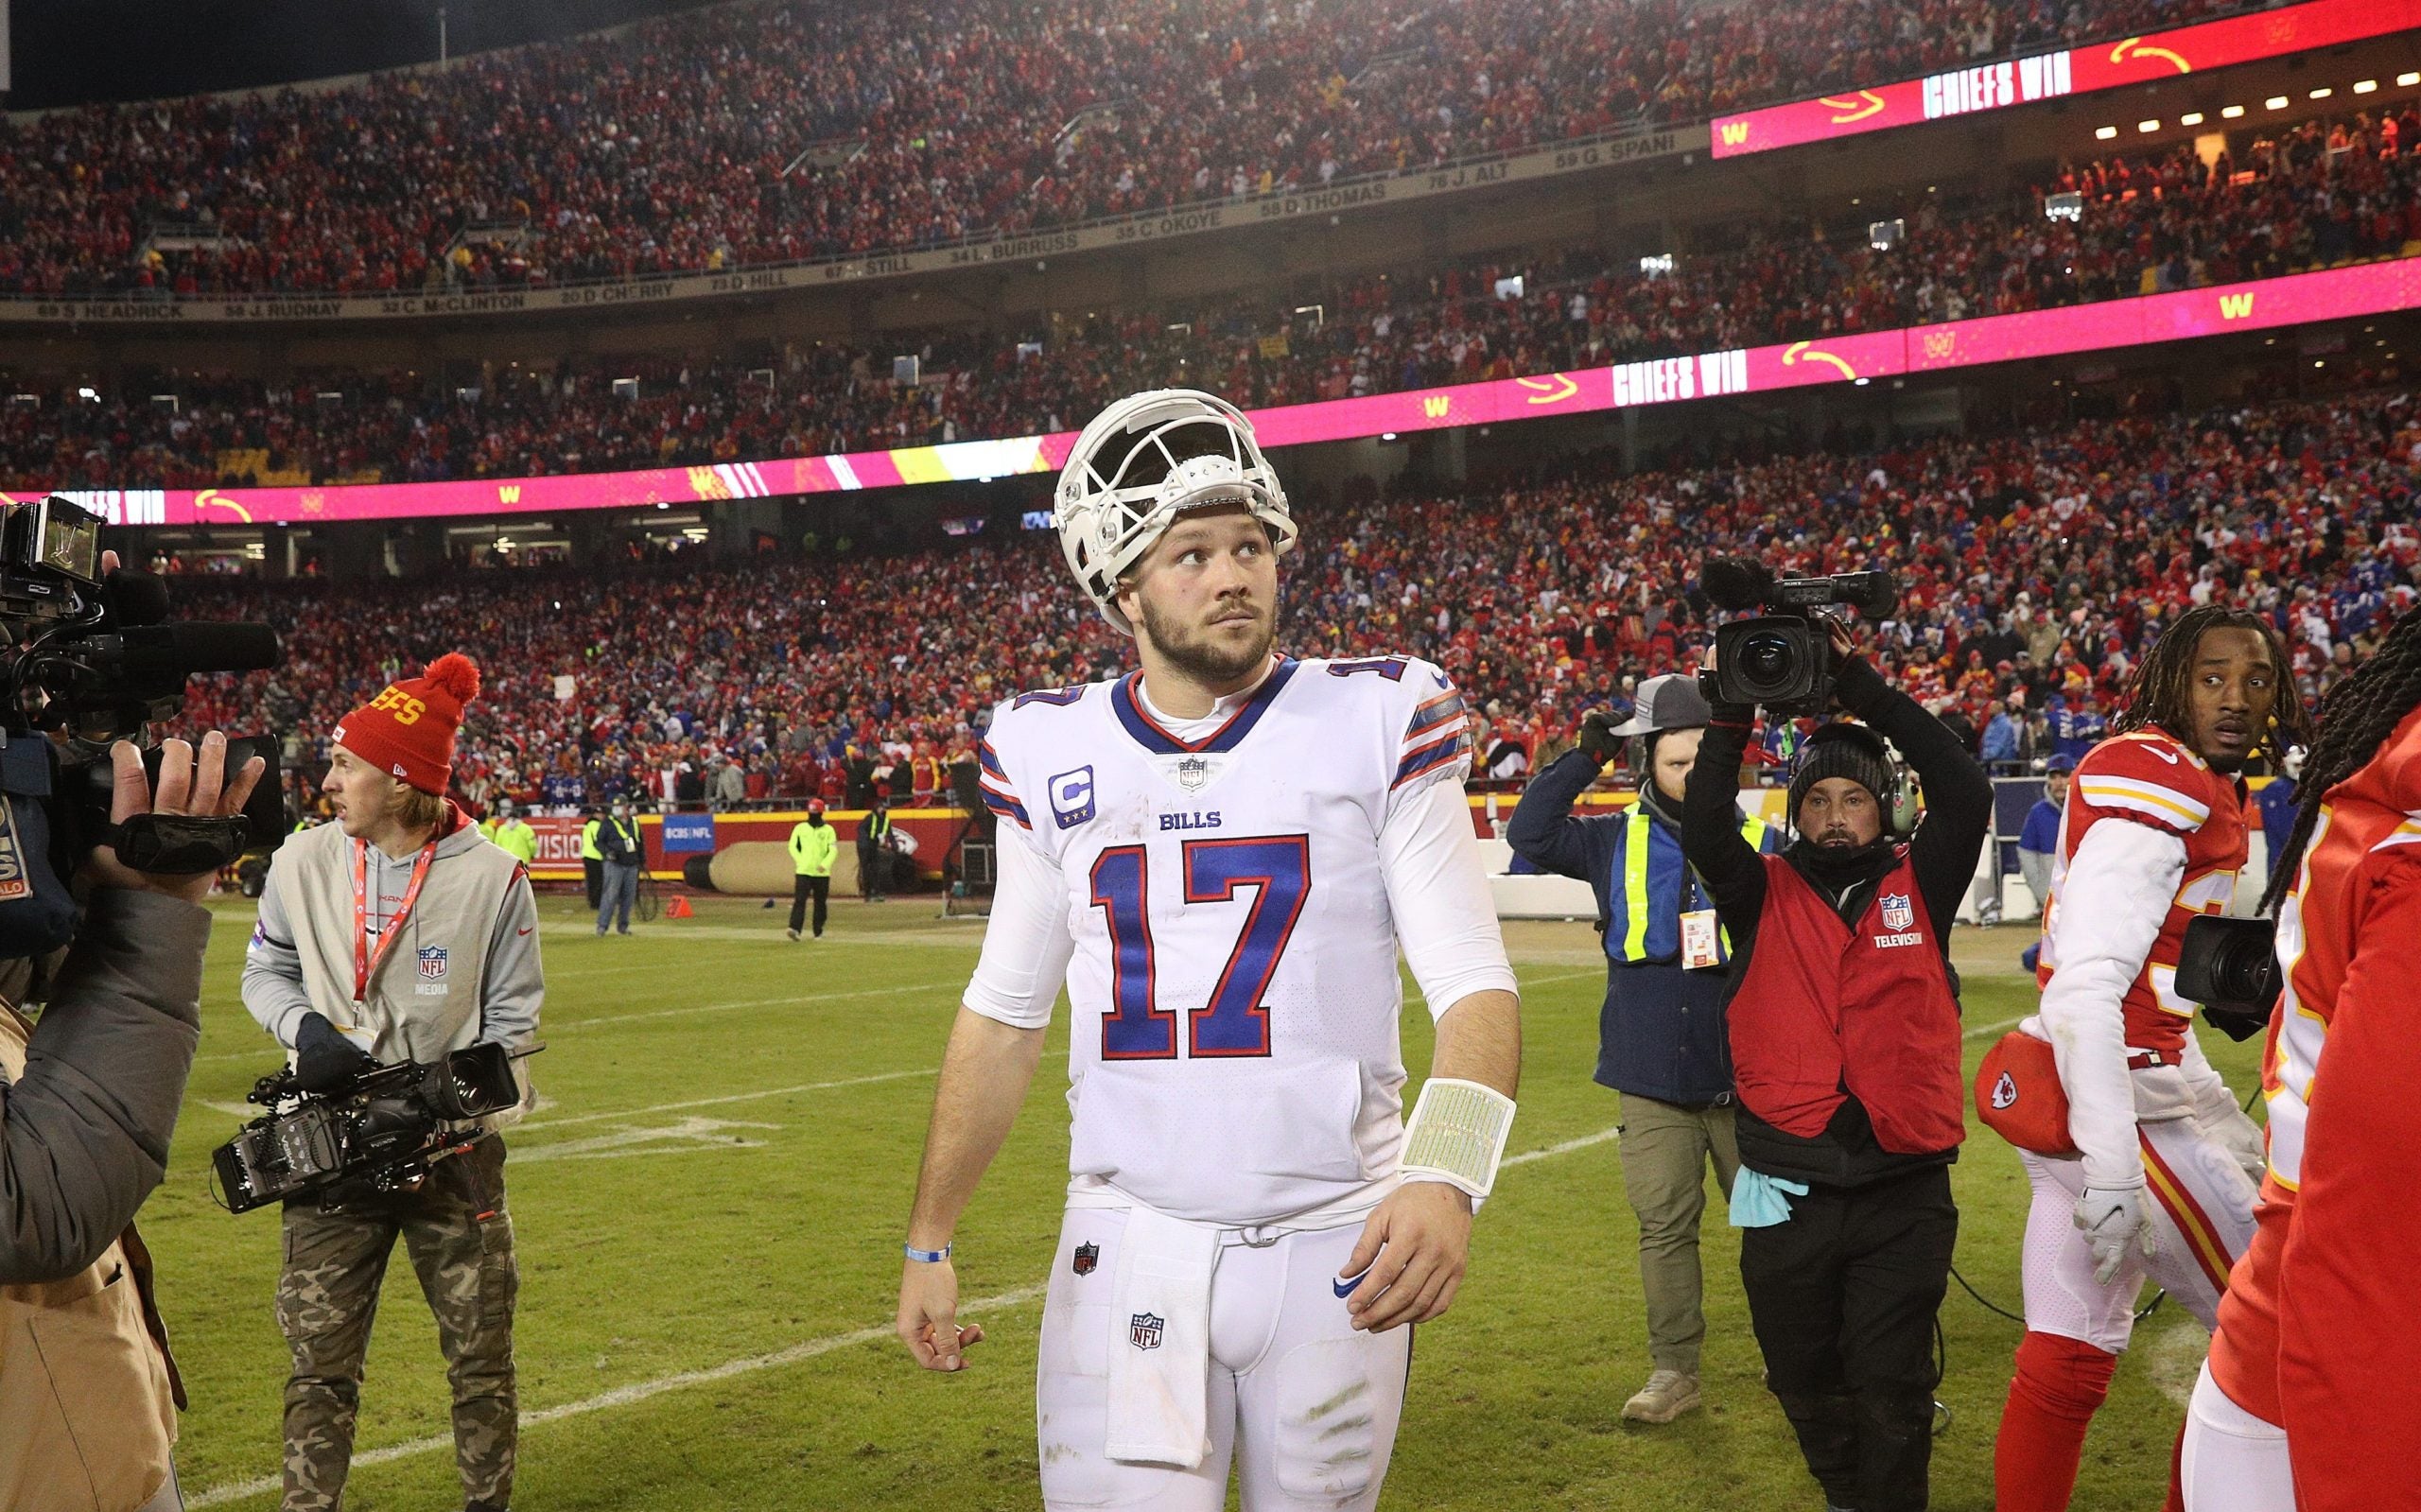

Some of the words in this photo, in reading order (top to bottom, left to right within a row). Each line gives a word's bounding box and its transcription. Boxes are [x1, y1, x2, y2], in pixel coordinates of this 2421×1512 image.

[1922, 61, 2014, 119] CHIEFS
[2018, 50, 2072, 101] WIN
[1721, 121, 1749, 146] W
[1611, 134, 1675, 160] SPANI
[1475, 163, 1508, 182] ALT
[1303, 182, 1385, 211] THOMAS
[1160, 210, 1222, 235] OKOYE
[992, 234, 1078, 259] BURRUSS
[866, 257, 913, 275] STILL
[751, 272, 789, 287] HILL
[2219, 291, 2255, 320] W
[1612, 355, 1695, 408] CHIEFS
[1699, 349, 1748, 396] WIN
[1424, 395, 1449, 418] W
[498, 485, 520, 504] W
[124, 490, 165, 525] WIN
[1051, 770, 1091, 813] C
[1158, 811, 1222, 830] BILLS
[1885, 910, 1909, 926] NFL
[1089, 833, 1313, 1061] 17
[421, 960, 444, 976] NFL
[414, 983, 448, 996] MEDIA
[1132, 1327, 1158, 1347] NFL
